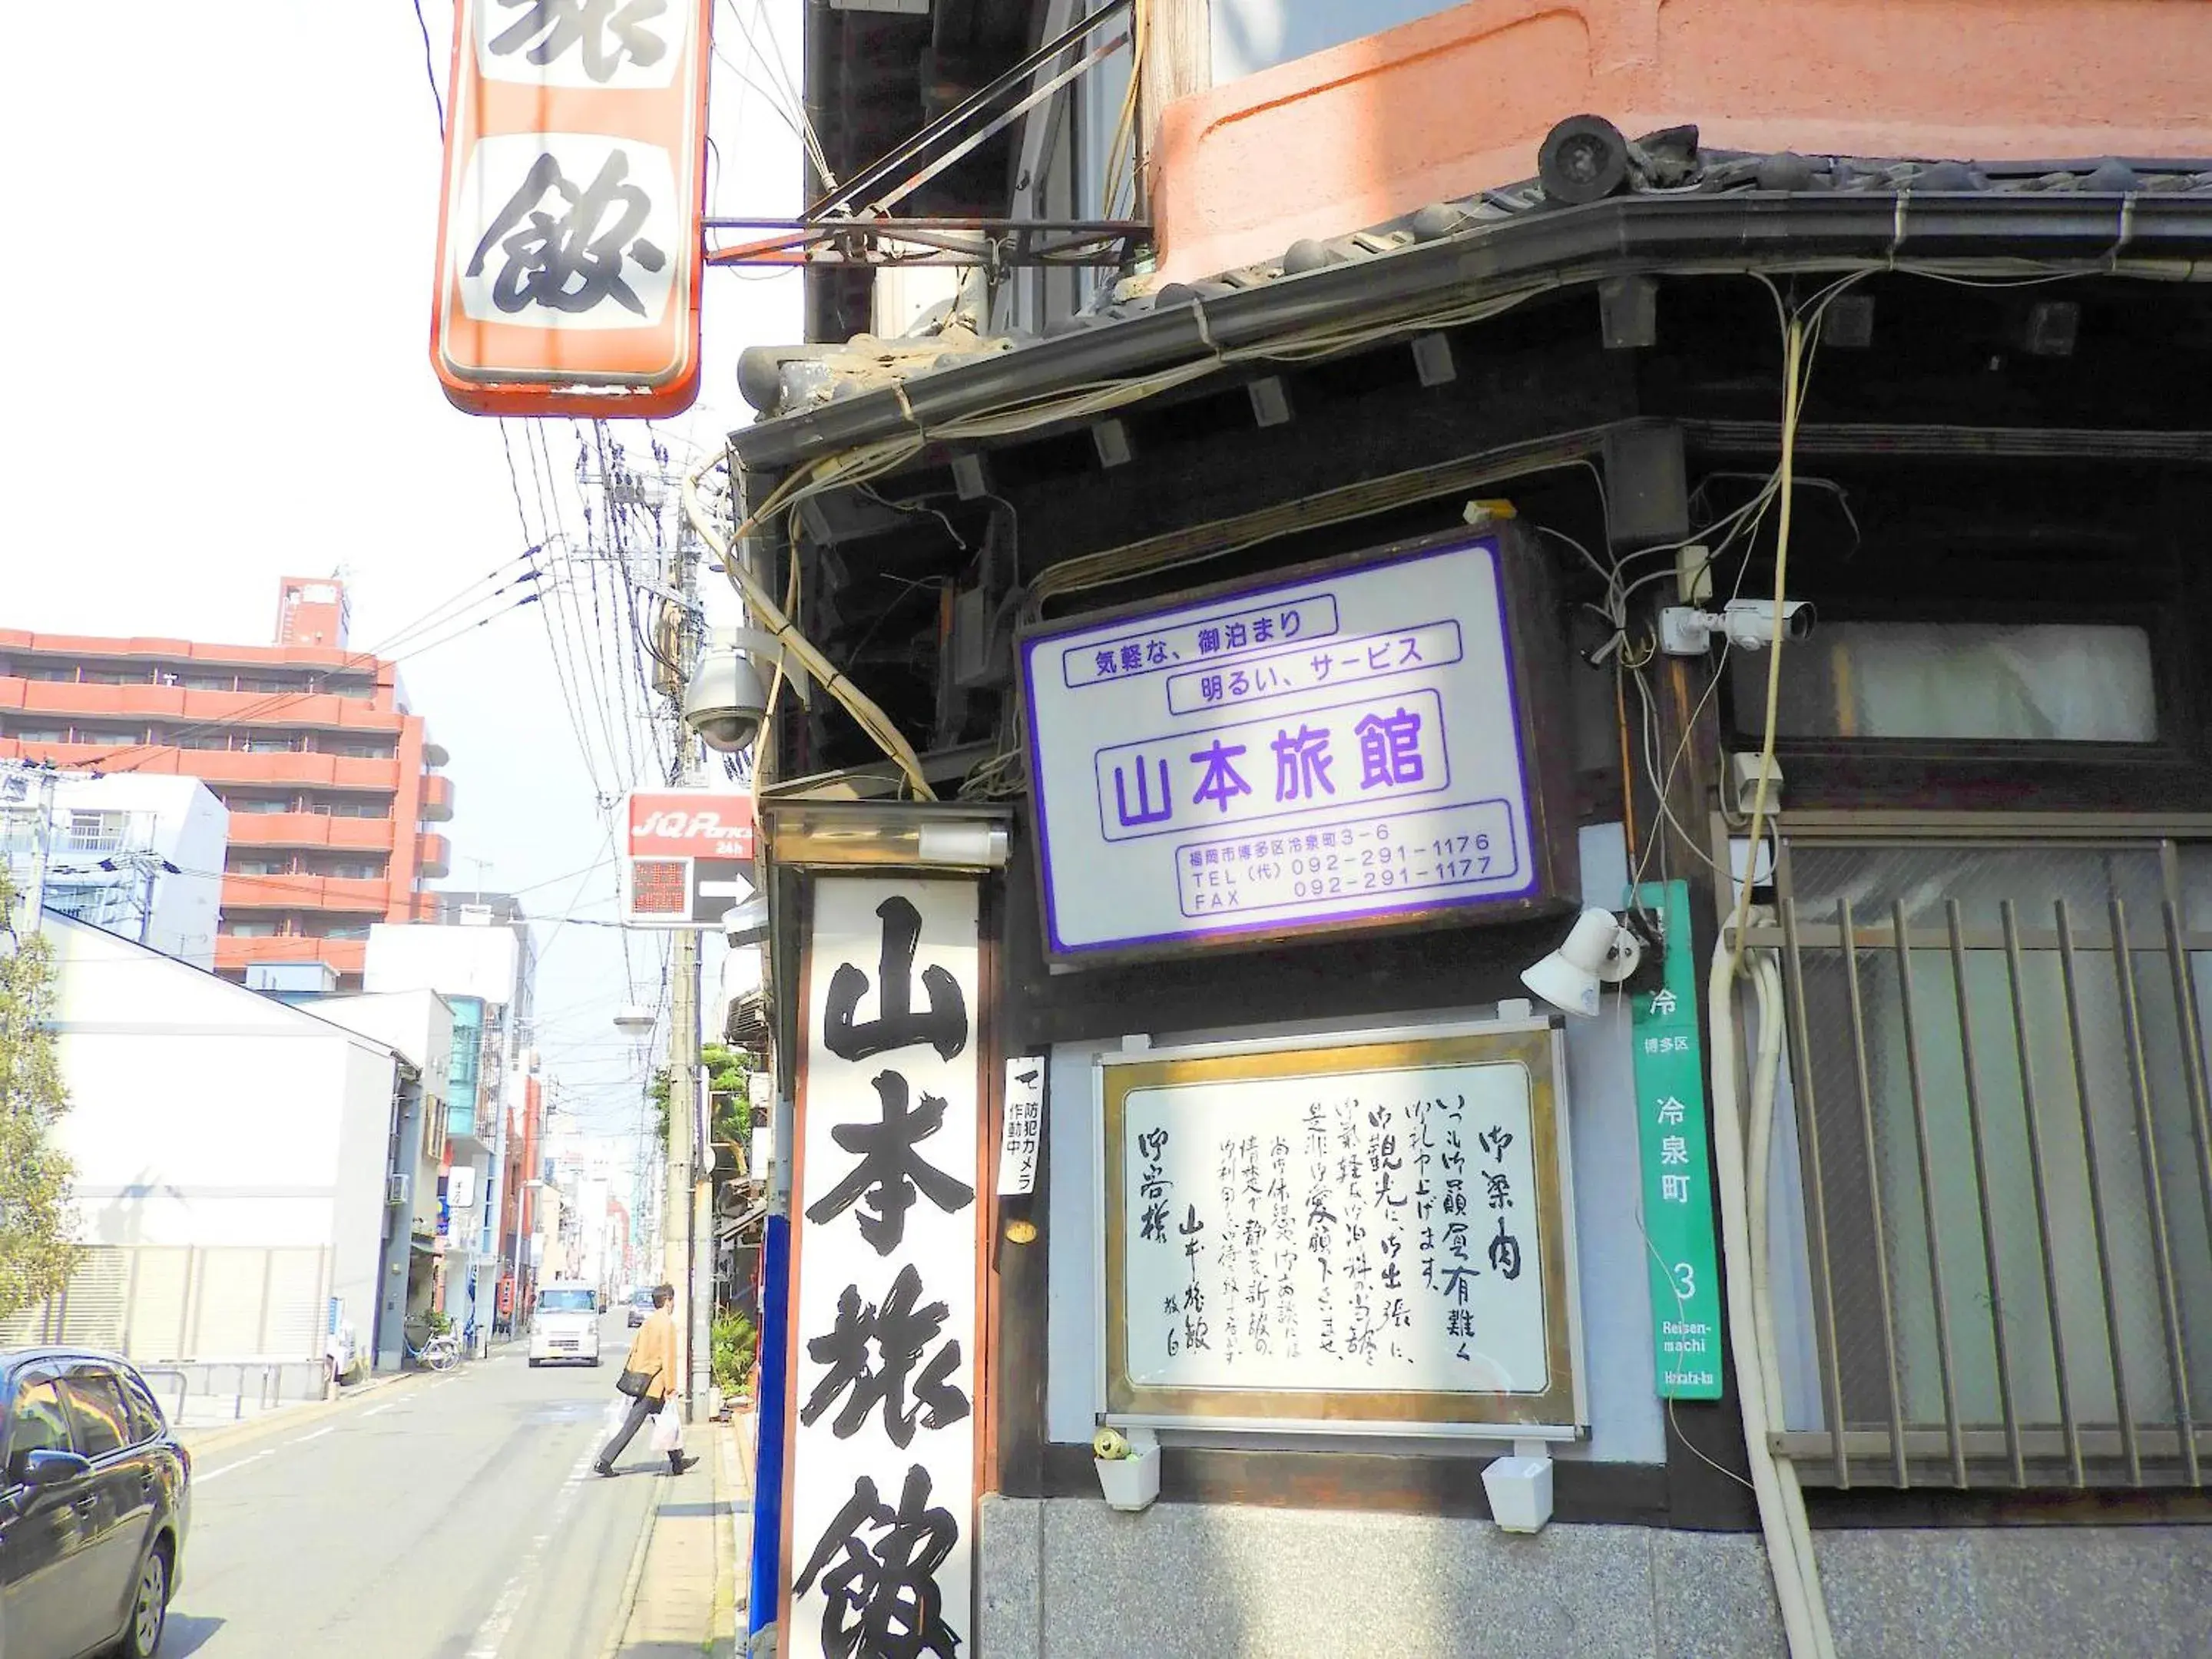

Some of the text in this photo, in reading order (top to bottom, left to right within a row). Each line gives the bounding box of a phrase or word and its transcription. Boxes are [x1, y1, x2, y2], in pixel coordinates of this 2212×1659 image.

[1095, 610, 1300, 676] 気軽な、御泊まり
[1202, 637, 1422, 702] 明るい、サービス
[1114, 708, 1424, 826] 山本旅館
[1192, 869, 1237, 888] TEL
[1292, 834, 1489, 876] 092-291-1176
[1195, 856, 1491, 910] FAX 092-291-1177
[1007, 1102, 1022, 1155] 作動中
[1019, 1102, 1038, 1190] 防犯カメラ
[1657, 1096, 1696, 1300] 冷泉町 3
[1664, 1339, 1706, 1353] machi
